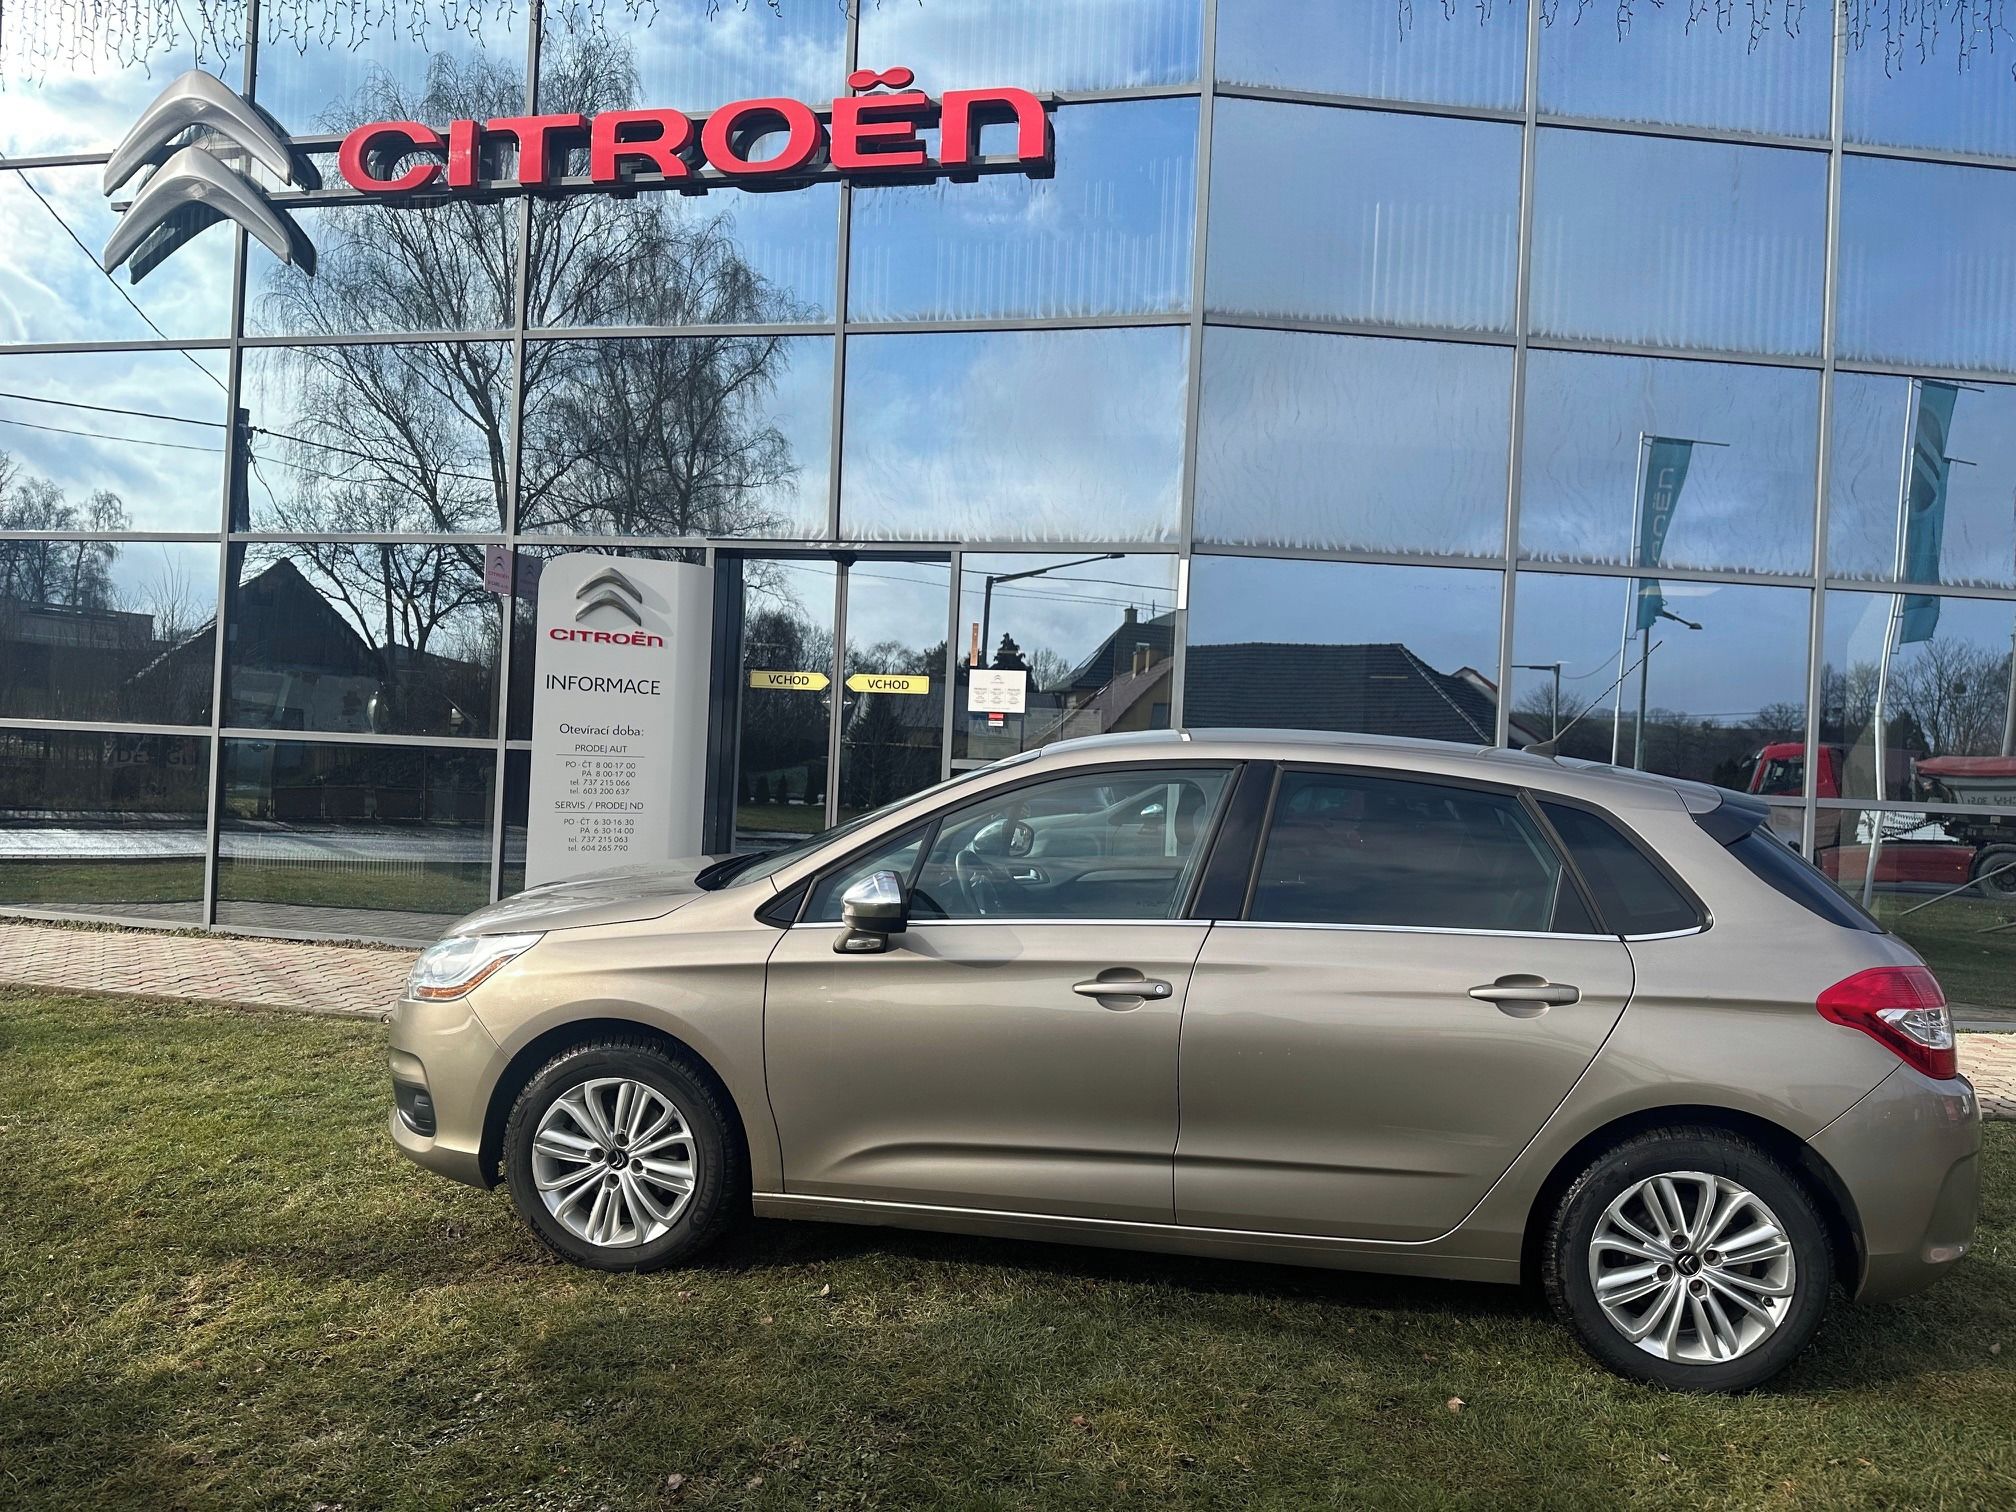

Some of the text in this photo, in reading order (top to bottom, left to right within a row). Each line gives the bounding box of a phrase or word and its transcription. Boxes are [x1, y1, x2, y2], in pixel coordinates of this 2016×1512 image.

[338, 66, 1053, 194] CITROËN
[549, 629, 663, 647] CITROËN
[546, 674, 661, 695] INFORMACE
[769, 674, 809, 686] VCHOD
[868, 679, 910, 690] VCHOD
[559, 723, 645, 737] Otevírací doba:
[575, 744, 628, 754] PRODEJ AUT
[565, 760, 577, 768] PO
[583, 787, 598, 795] 603
[599, 787, 614, 795] 200
[554, 801, 586, 809] SERVIS
[595, 801, 628, 810] PRODEJ
[629, 801, 644, 810] ND
